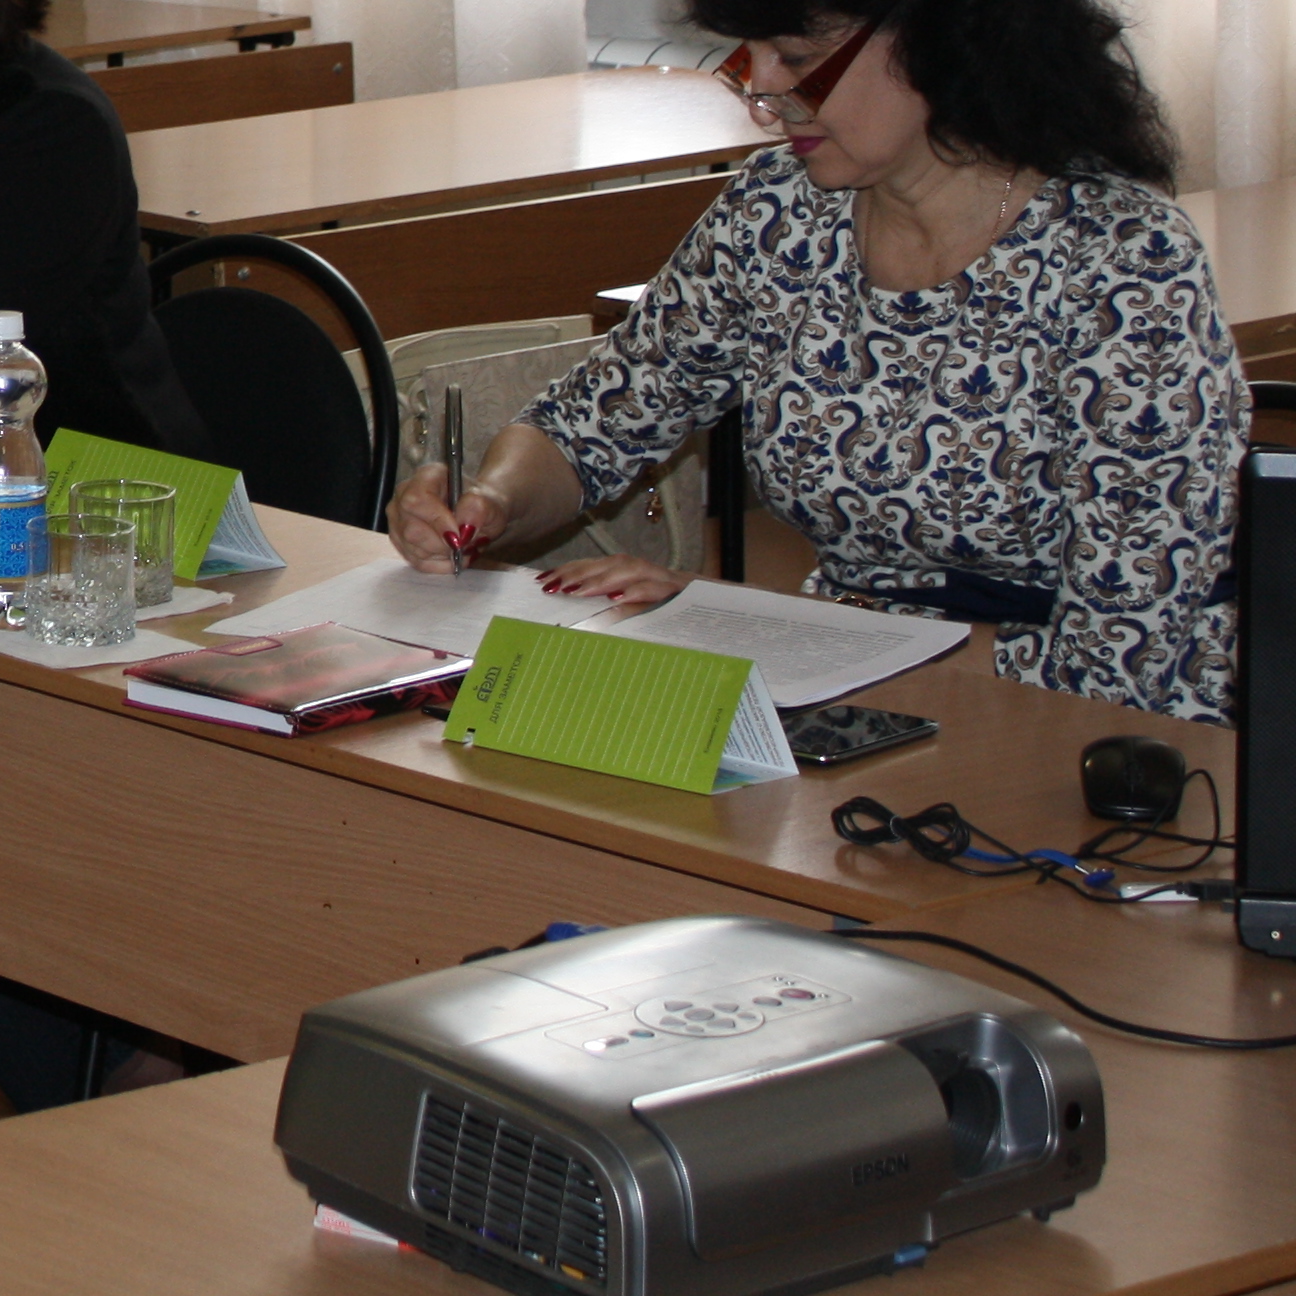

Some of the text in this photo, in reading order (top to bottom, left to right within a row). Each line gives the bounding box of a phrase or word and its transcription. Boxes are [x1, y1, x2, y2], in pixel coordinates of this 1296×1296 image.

[489, 652, 524, 724] ДЛЯ ЗАМЕТОК
[850, 1151, 910, 1188] EPSON
